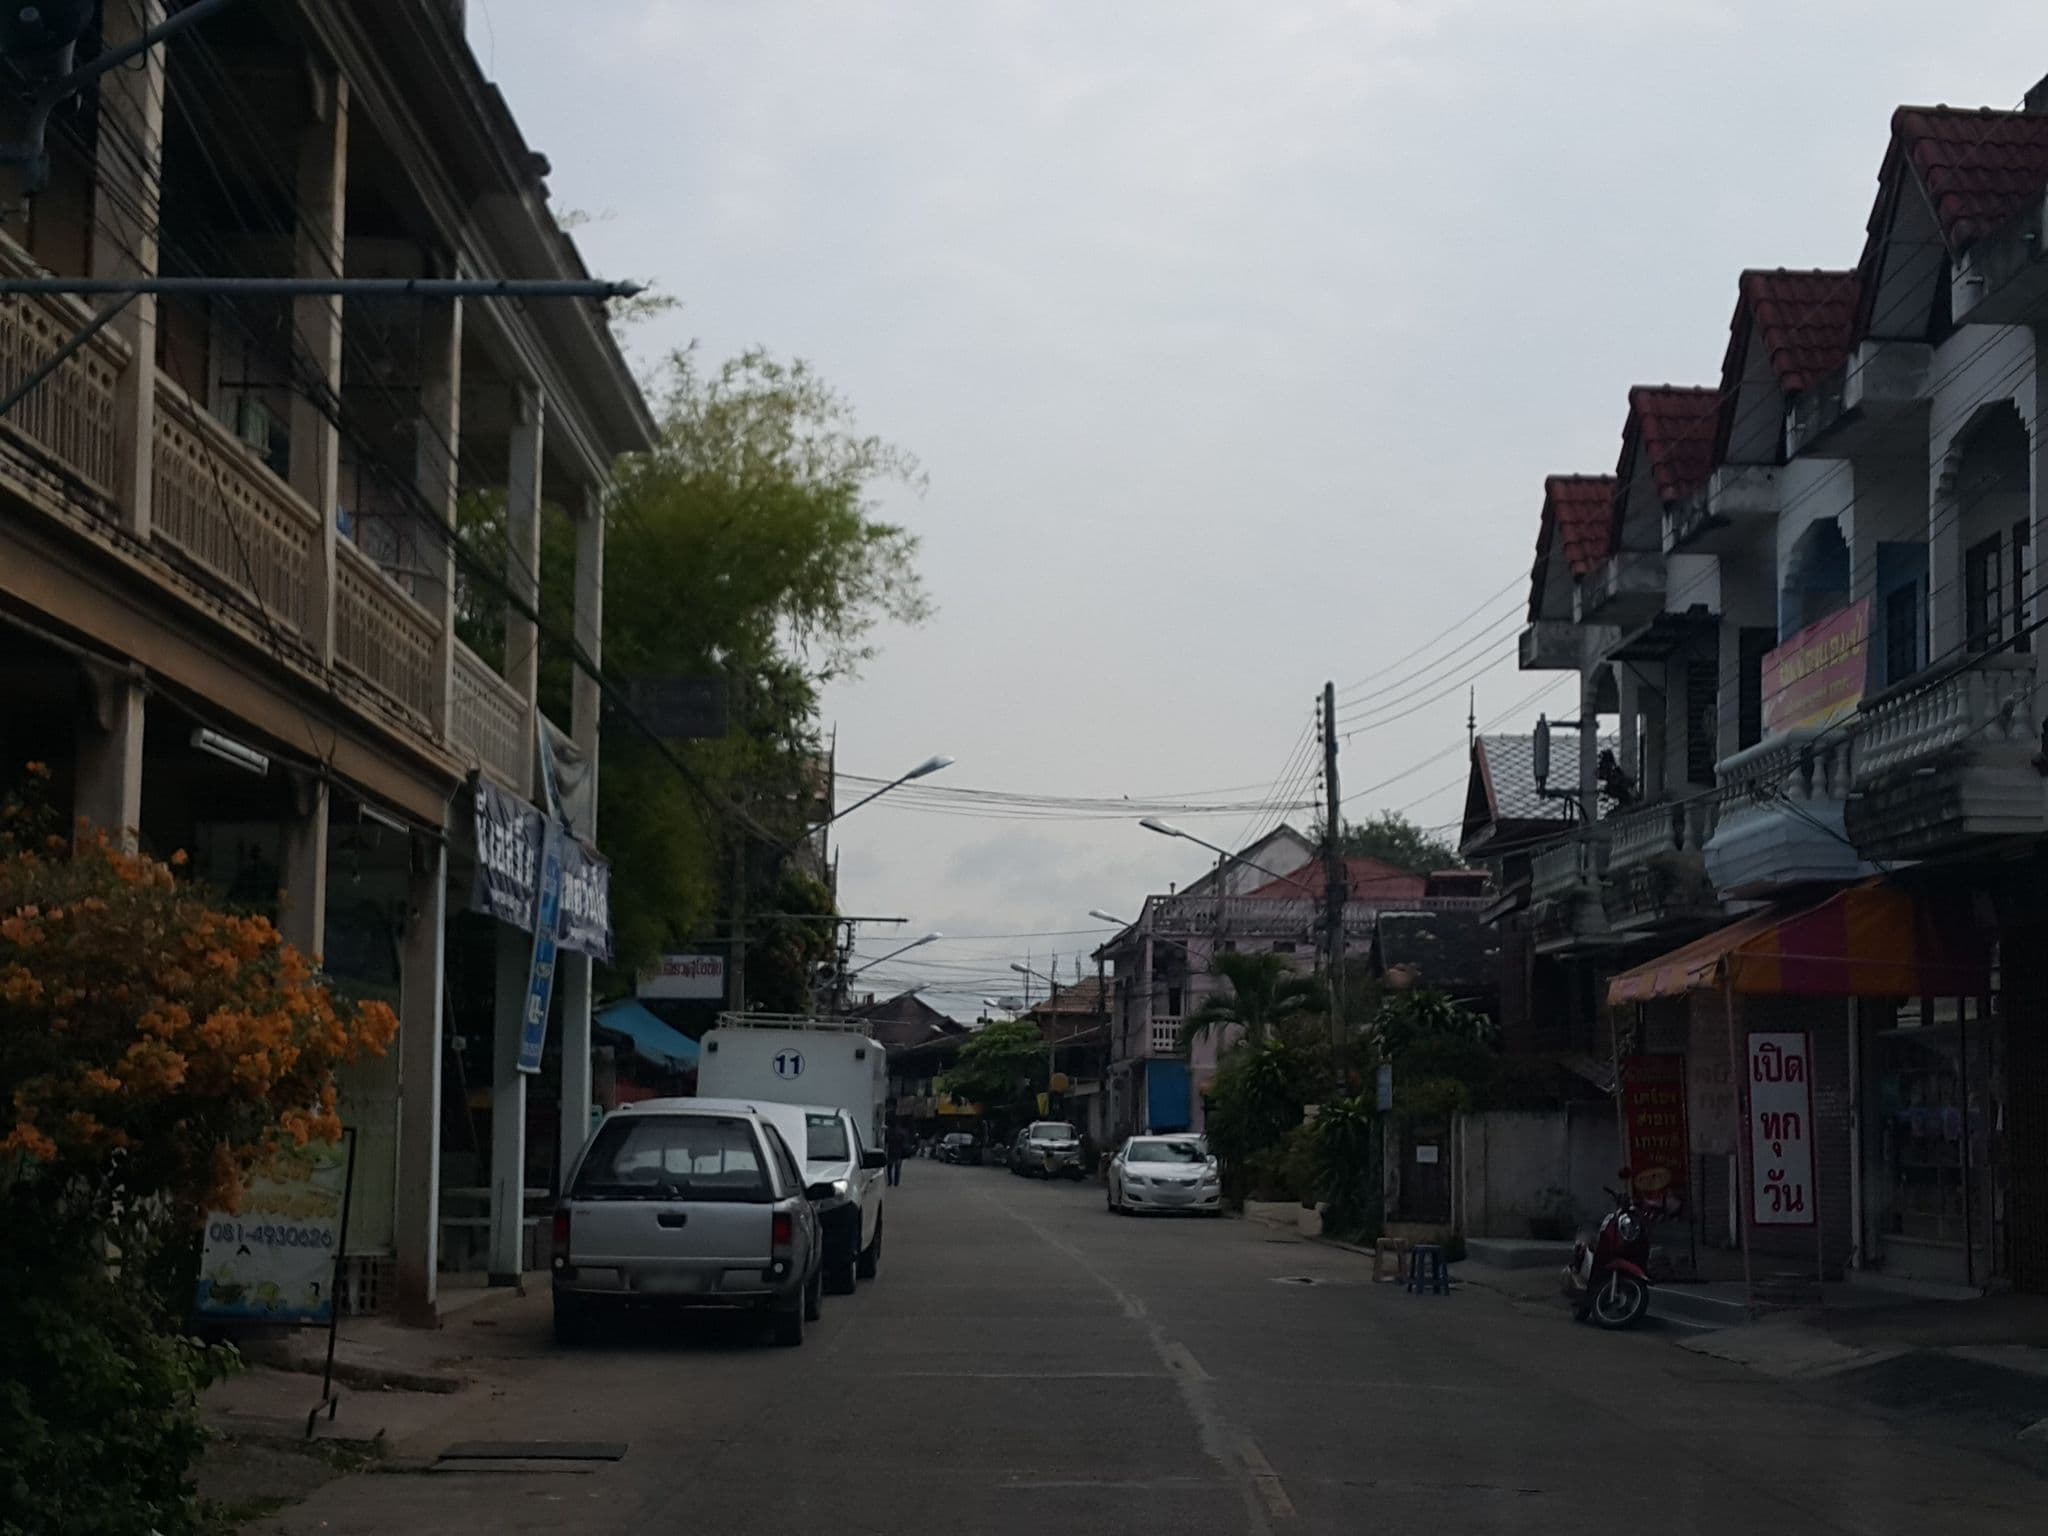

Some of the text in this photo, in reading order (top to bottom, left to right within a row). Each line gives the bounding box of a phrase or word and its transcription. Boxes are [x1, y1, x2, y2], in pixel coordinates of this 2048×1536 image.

[775, 1055, 800, 1075] 11
[1753, 1042, 1804, 1083] เปิด
[1760, 1112, 1801, 1158] ทุก
[1763, 1168, 1804, 1213] วัน
